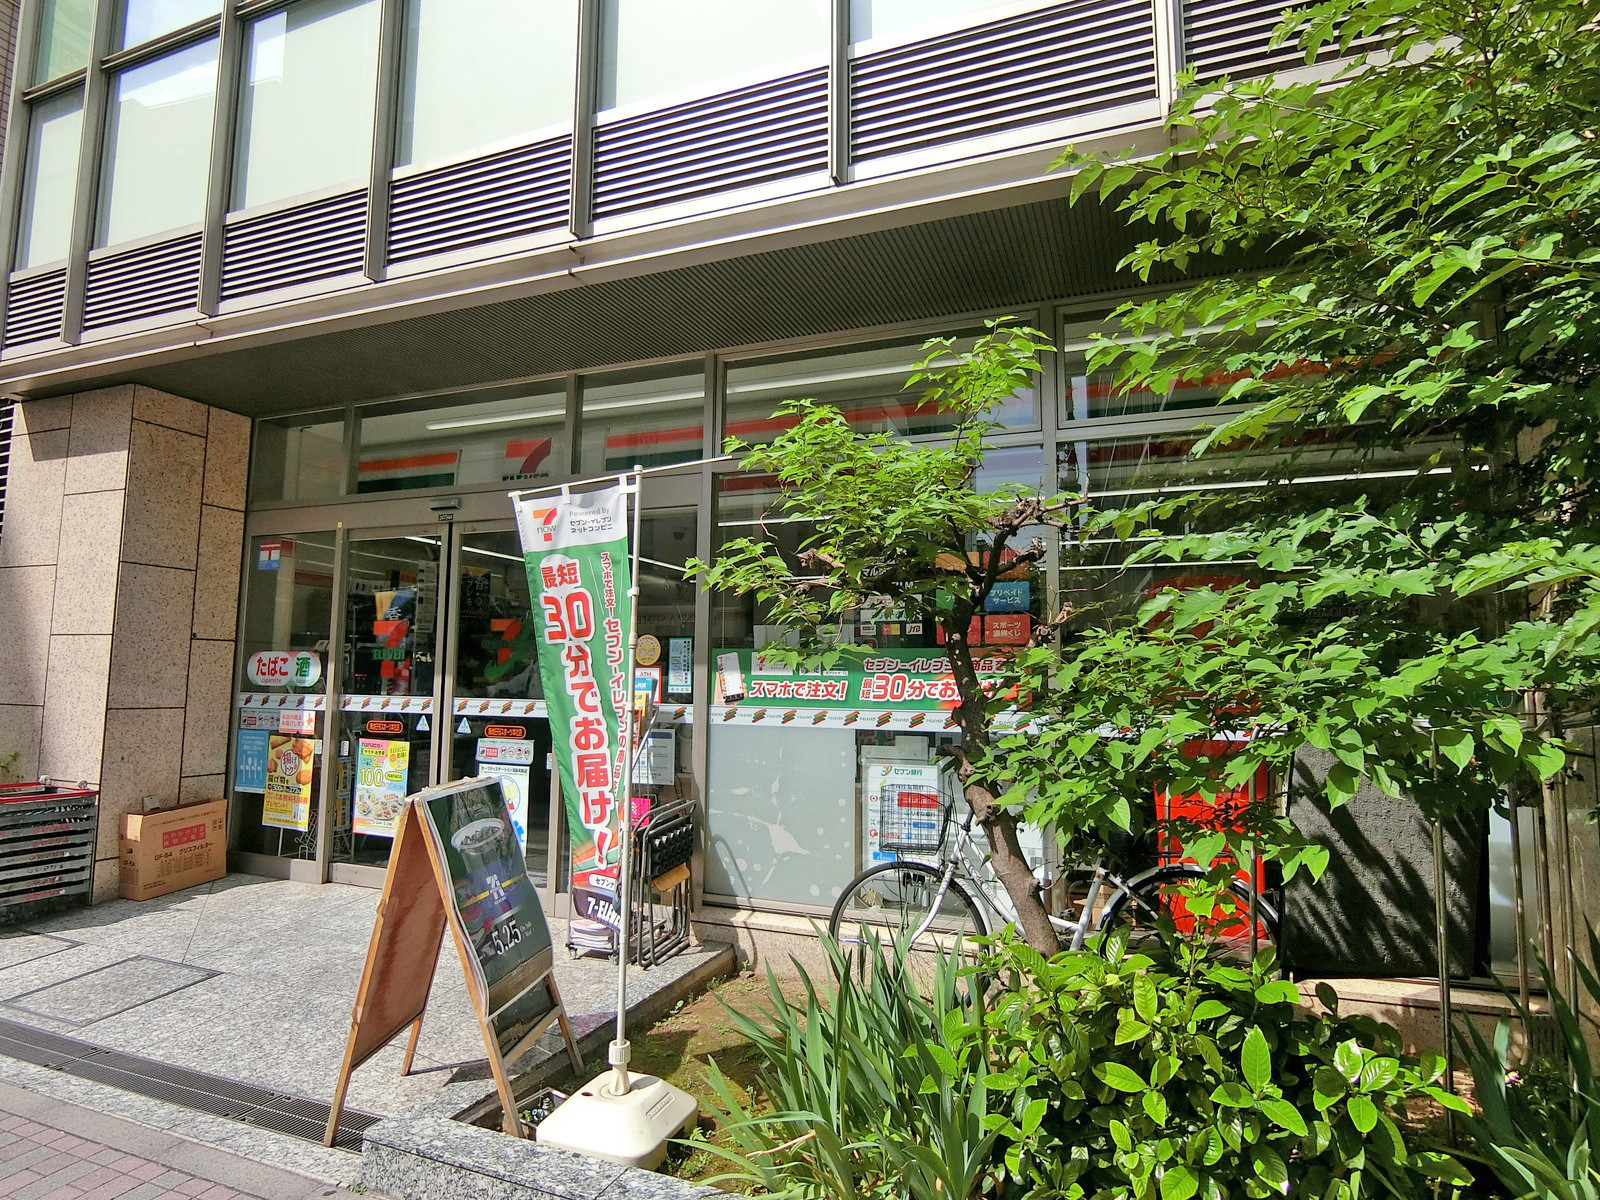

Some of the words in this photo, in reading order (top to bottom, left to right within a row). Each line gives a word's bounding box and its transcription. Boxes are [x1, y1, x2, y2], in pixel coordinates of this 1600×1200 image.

[569, 508, 597, 518] Powered
[601, 507, 610, 515] by
[537, 525, 557, 534] now
[571, 524, 613, 534] ネットコンビニ
[541, 562, 579, 589] 最短
[601, 552, 616, 616] スマホで注文!
[990, 588, 1023, 597] プリペイド
[993, 596, 1021, 604] サービス
[543, 591, 592, 641] 30
[992, 621, 1021, 629] スポーツ
[256, 656, 289, 676] たばこ
[295, 657, 311, 677] 酒
[750, 681, 847, 699] スマホで注文!
[860, 678, 873, 699] 最短
[873, 675, 907, 700] 30
[894, 767, 923, 776] セブン銀行
[491, 919, 522, 955] 5.25
